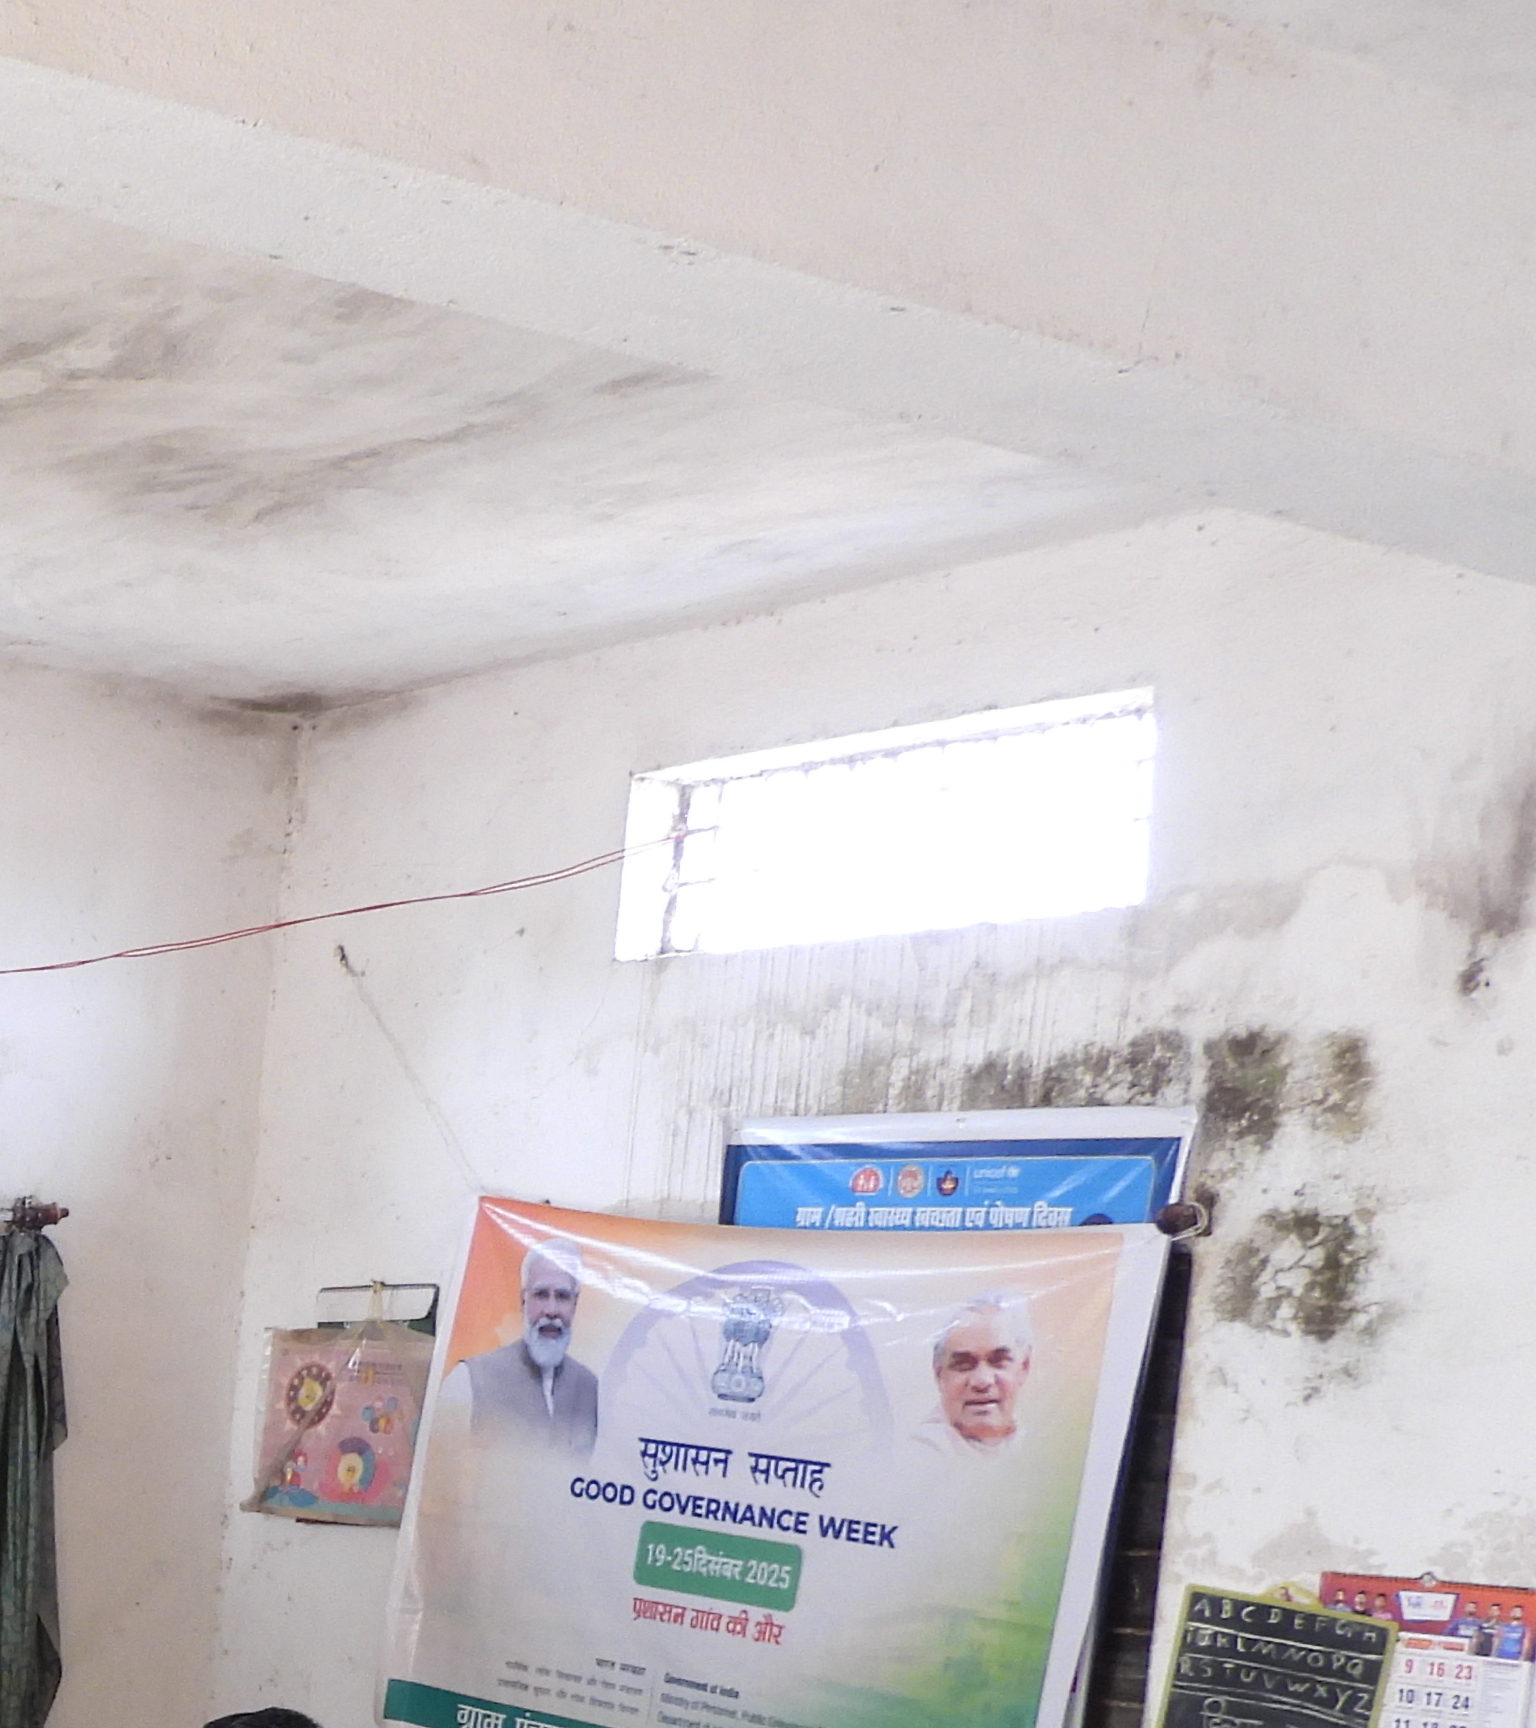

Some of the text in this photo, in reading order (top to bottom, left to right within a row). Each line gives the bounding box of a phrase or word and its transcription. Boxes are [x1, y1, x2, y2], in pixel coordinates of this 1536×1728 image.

[638, 1437, 832, 1497] सुशासन सप्ताह
[570, 1477, 899, 1549] GOOD GOVERNANCE WEEK
[745, 1560, 793, 1590] 2025
[632, 1596, 686, 1625] प्रशासन
[725, 1609, 750, 1639] की
